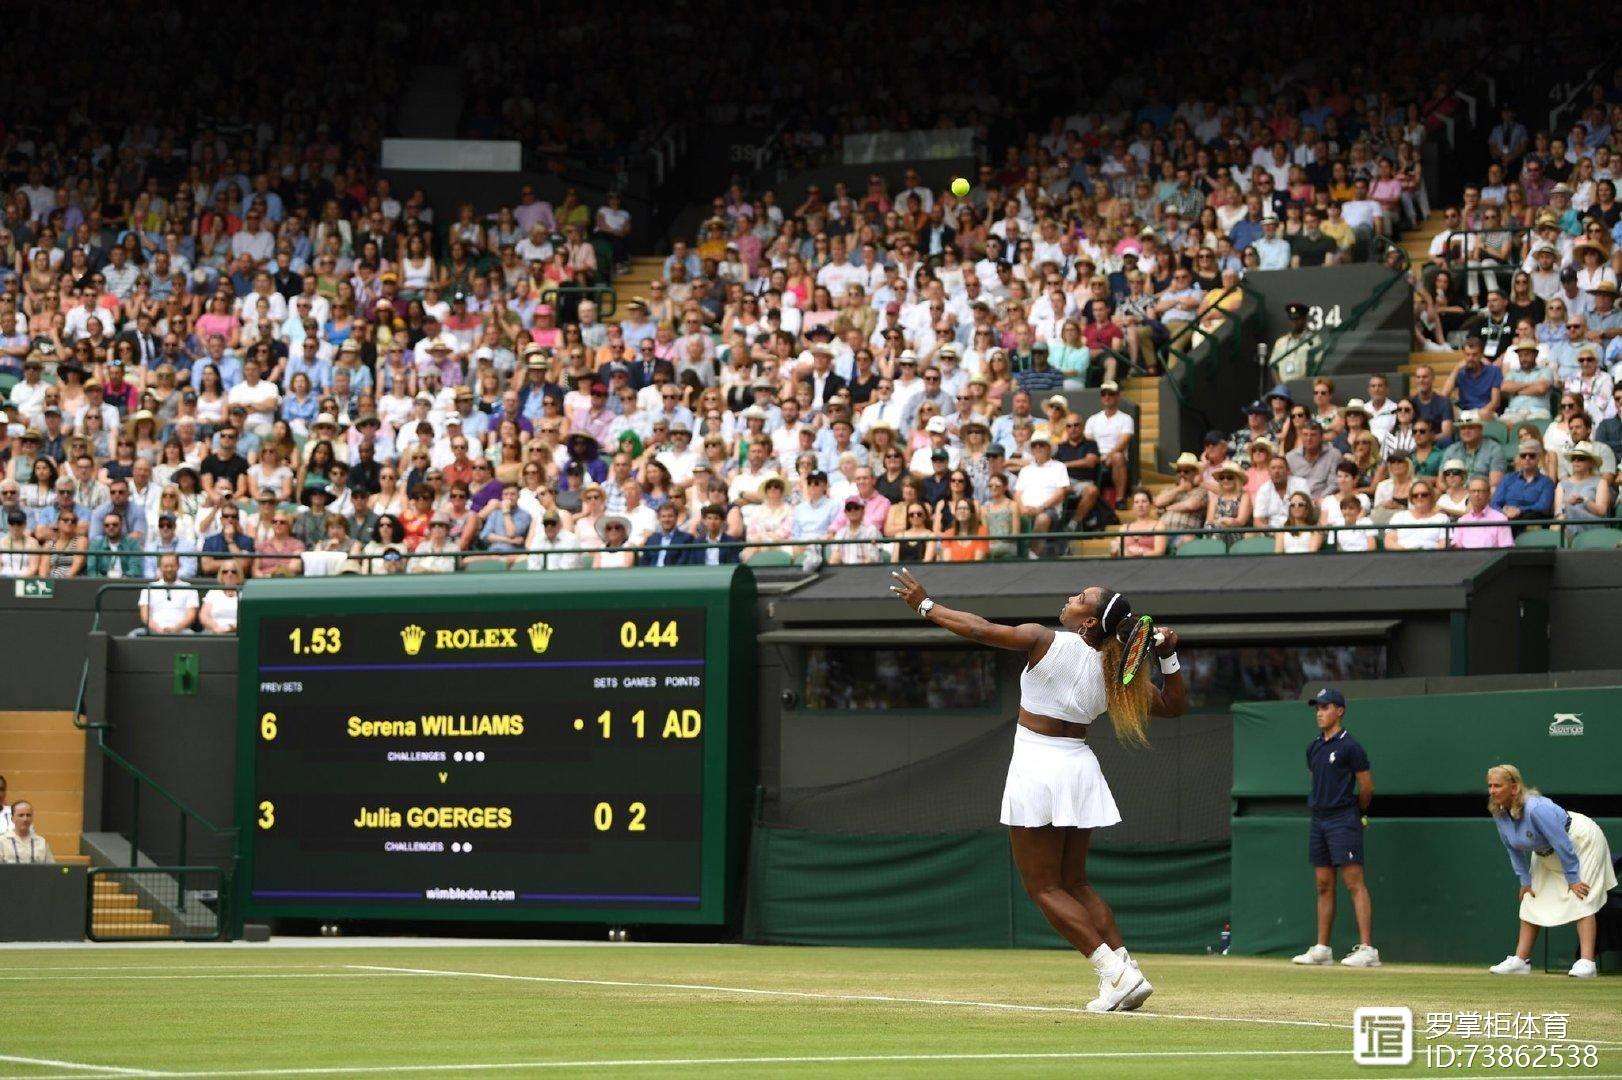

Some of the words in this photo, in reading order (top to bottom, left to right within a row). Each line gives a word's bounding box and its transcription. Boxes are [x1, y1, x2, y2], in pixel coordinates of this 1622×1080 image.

[1308, 304, 1342, 331] 34
[288, 627, 342, 655] 1.53
[435, 628, 519, 650] ROLEX
[620, 620, 679, 648] 0.44
[593, 677, 618, 688] SETS
[622, 676, 657, 688] GAMES
[664, 676, 701, 688] POINTS
[260, 712, 278, 741] 6
[346, 716, 416, 738] Serena
[420, 715, 525, 737] WILLIAMS
[597, 709, 612, 739] 1
[631, 709, 646, 739] 1
[661, 709, 702, 739] AD
[386, 750, 447, 762] CHALLENGES
[258, 800, 275, 830] 3
[353, 806, 402, 828] Julia
[406, 807, 513, 828] GOERGES
[593, 801, 613, 832] 0
[627, 801, 647, 832] 2
[384, 841, 445, 853] CHALLENGES
